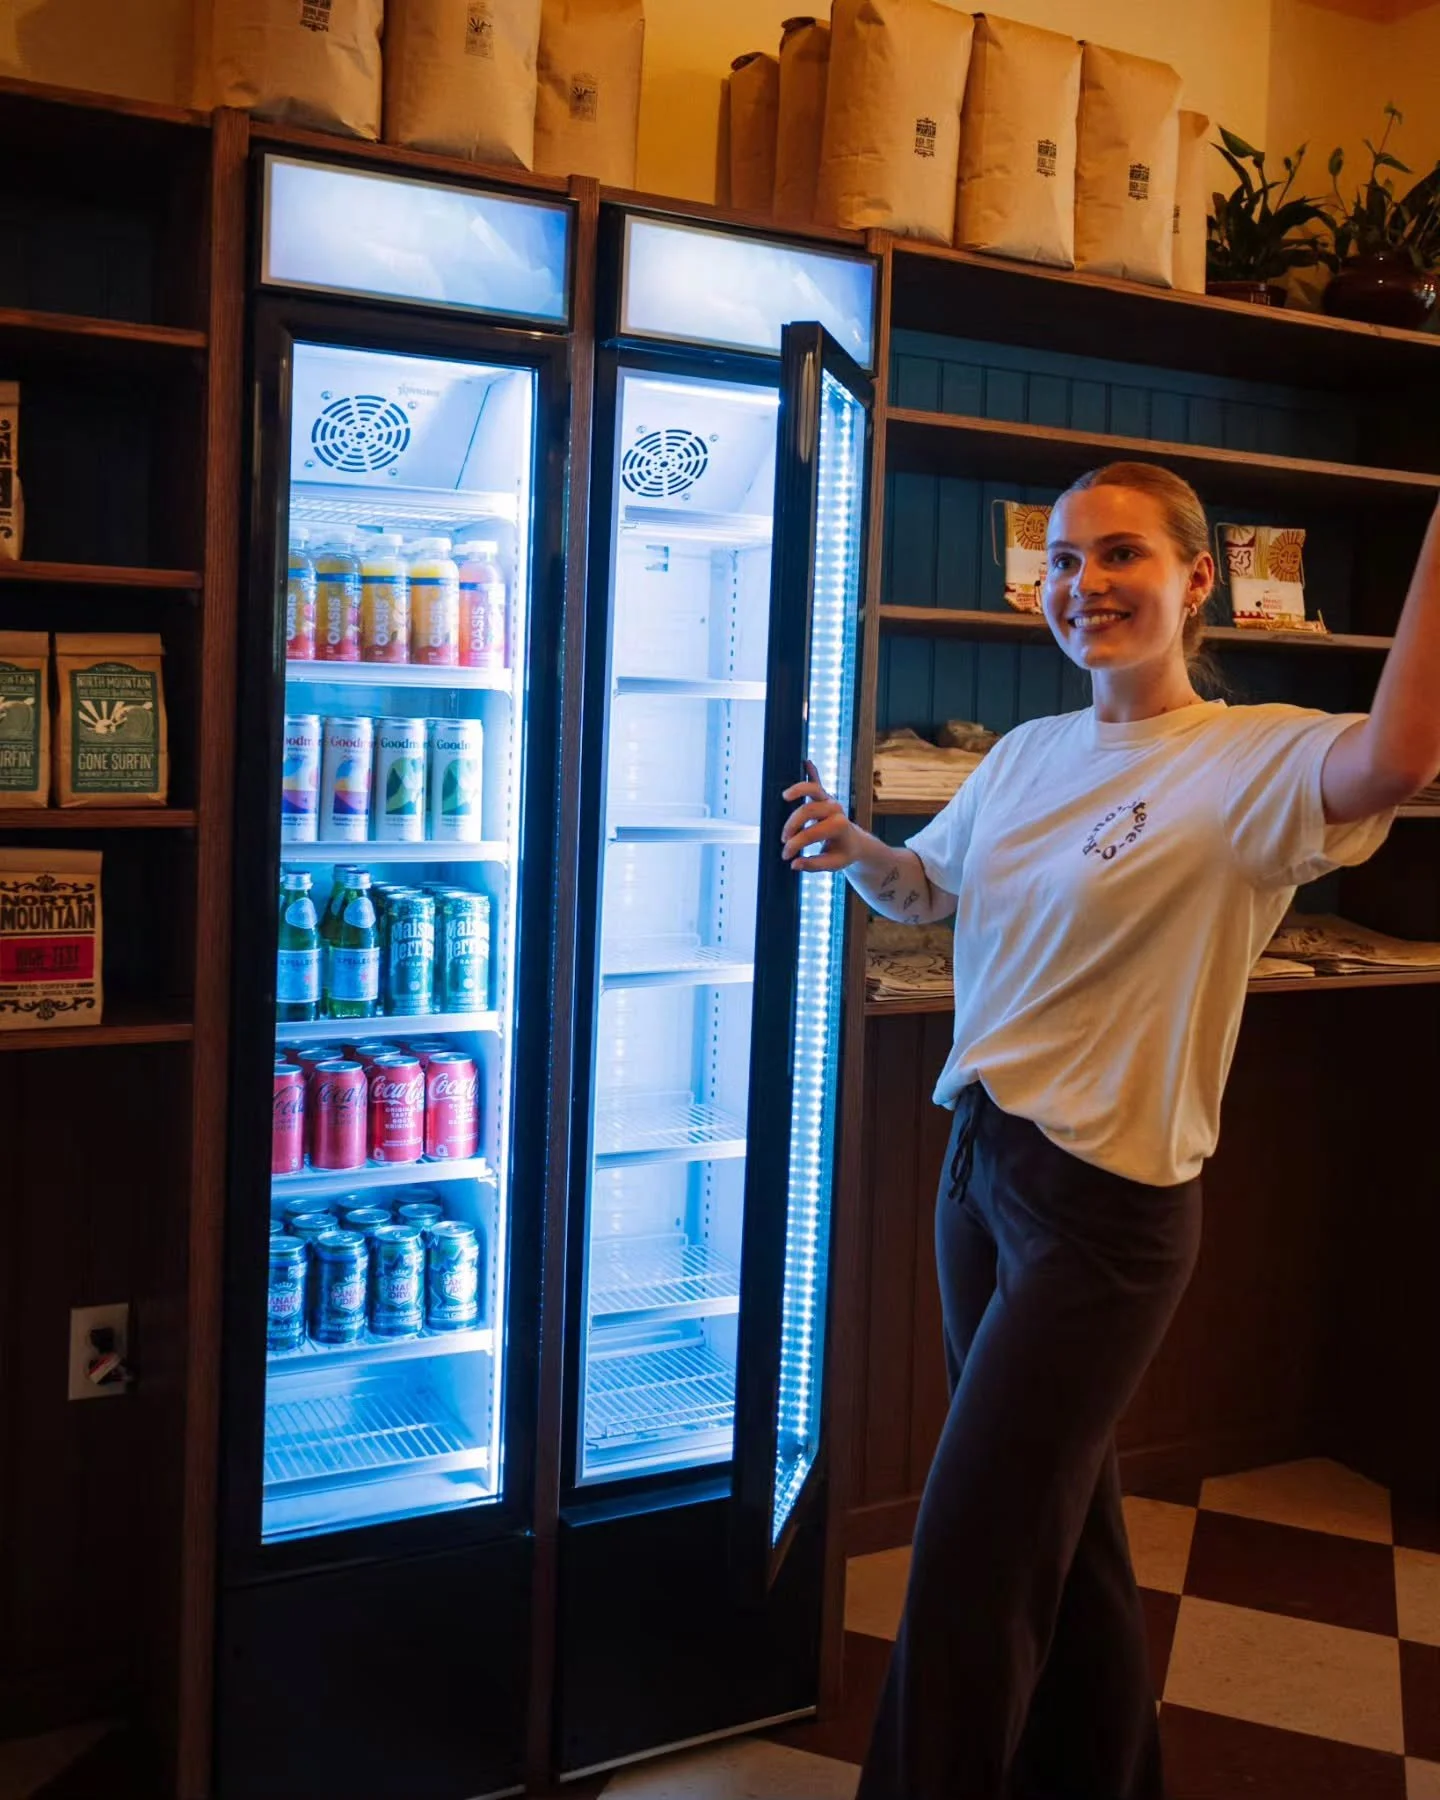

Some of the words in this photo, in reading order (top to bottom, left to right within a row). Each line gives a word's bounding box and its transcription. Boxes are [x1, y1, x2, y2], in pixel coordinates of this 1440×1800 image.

[328, 597, 341, 645] OASIS
[471, 606, 486, 651] OASIS
[78, 752, 109, 771] GONE
[1, 893, 95, 907] NORTH
[0, 905, 95, 930] MOUNTAIN
